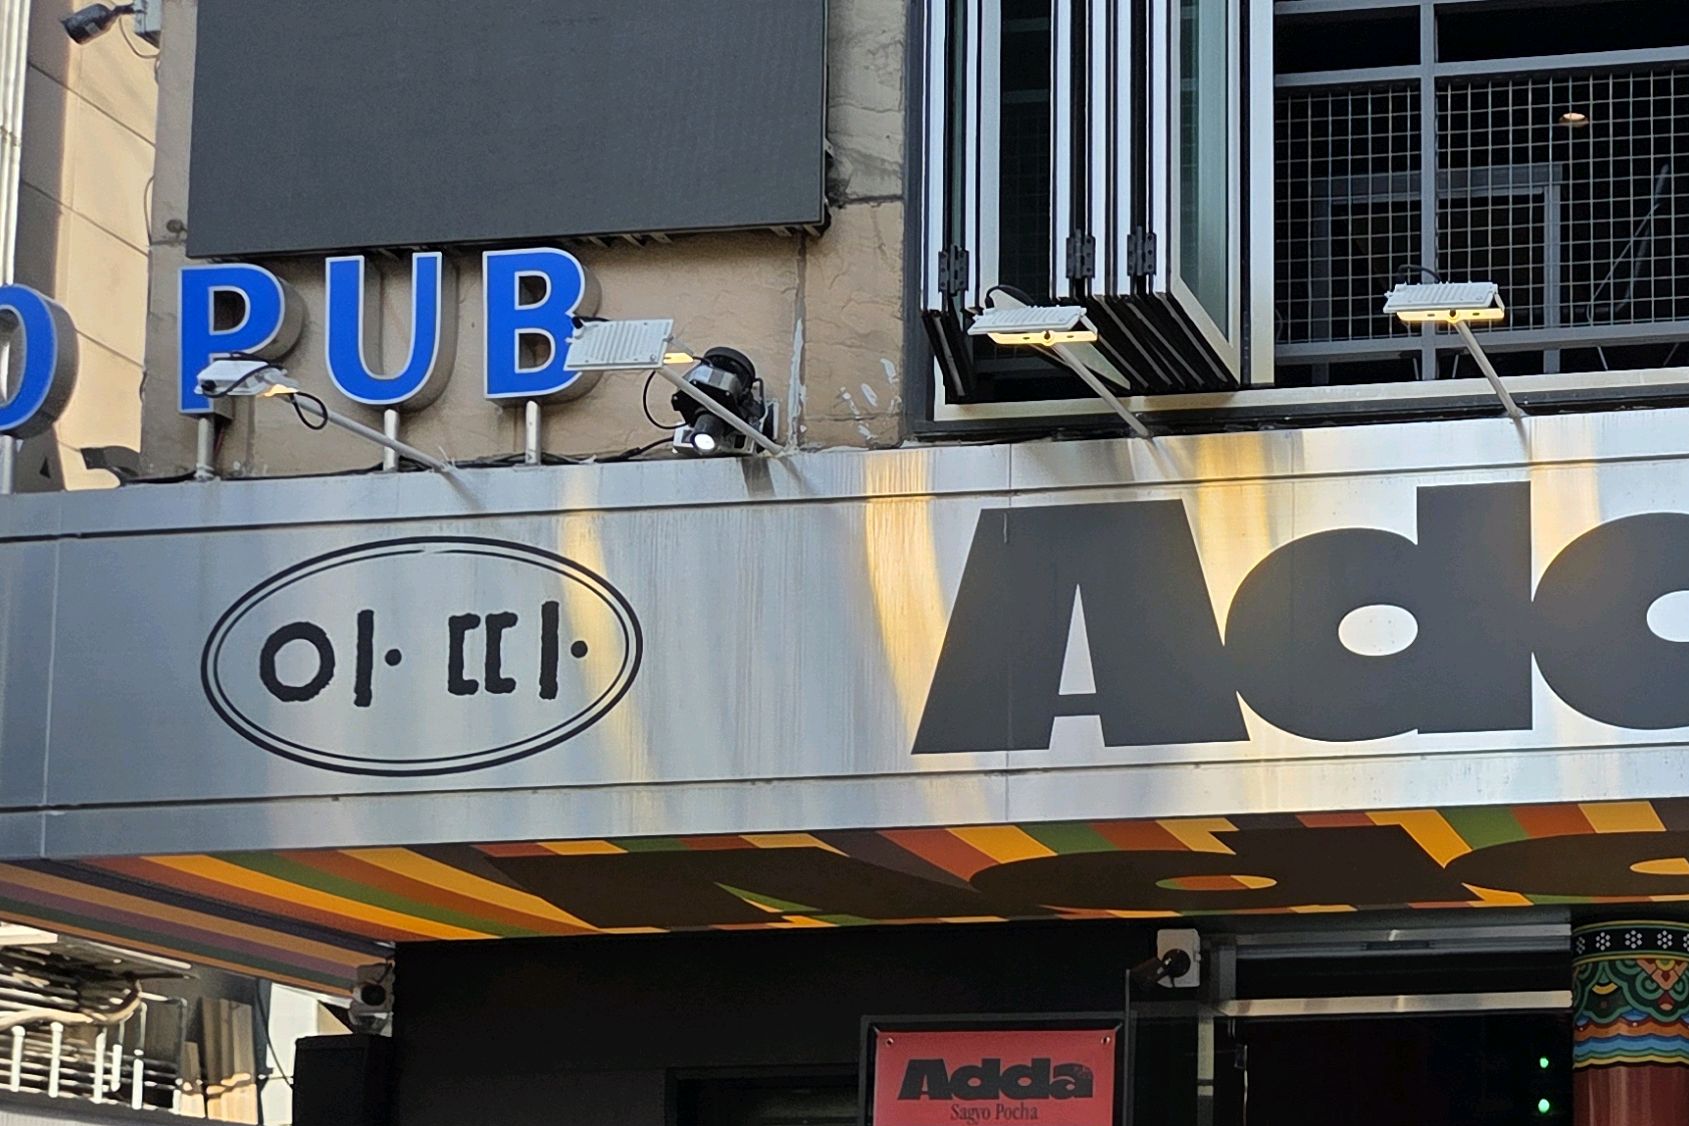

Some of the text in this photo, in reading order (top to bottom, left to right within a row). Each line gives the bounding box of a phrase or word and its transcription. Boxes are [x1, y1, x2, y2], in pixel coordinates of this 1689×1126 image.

[179, 247, 587, 414] PUB
[898, 1057, 1094, 1101] Adda
[951, 1102, 1038, 1125] Sagyo Pocha
